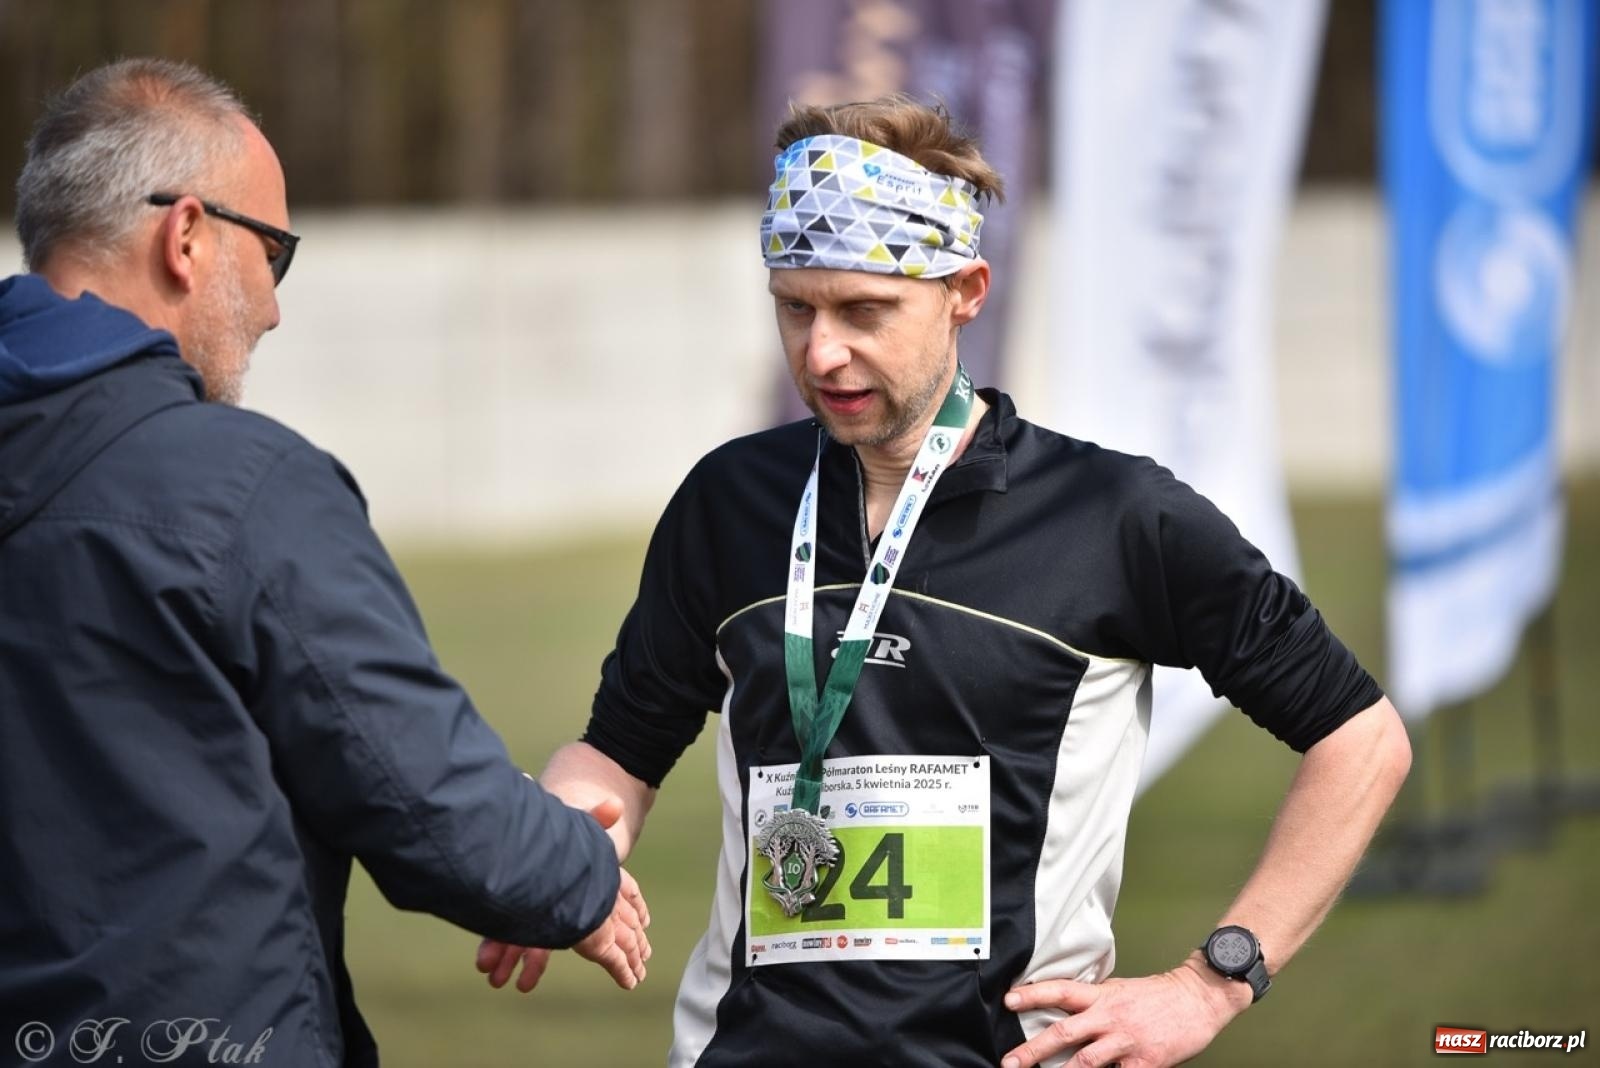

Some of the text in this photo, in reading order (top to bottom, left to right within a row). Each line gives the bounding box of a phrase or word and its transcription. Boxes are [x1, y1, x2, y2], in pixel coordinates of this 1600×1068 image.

[877, 174, 921, 195] Esprit
[765, 773, 773, 783] X
[774, 770, 797, 783] Kuźn
[875, 763, 907, 775] Leśny
[909, 763, 968, 775] RAFAMET
[822, 780, 855, 792] borska,
[855, 778, 861, 790] 5
[863, 778, 911, 789] kwietnia
[914, 778, 942, 789] 2025
[944, 781, 952, 789] r.
[800, 833, 912, 923] 24
